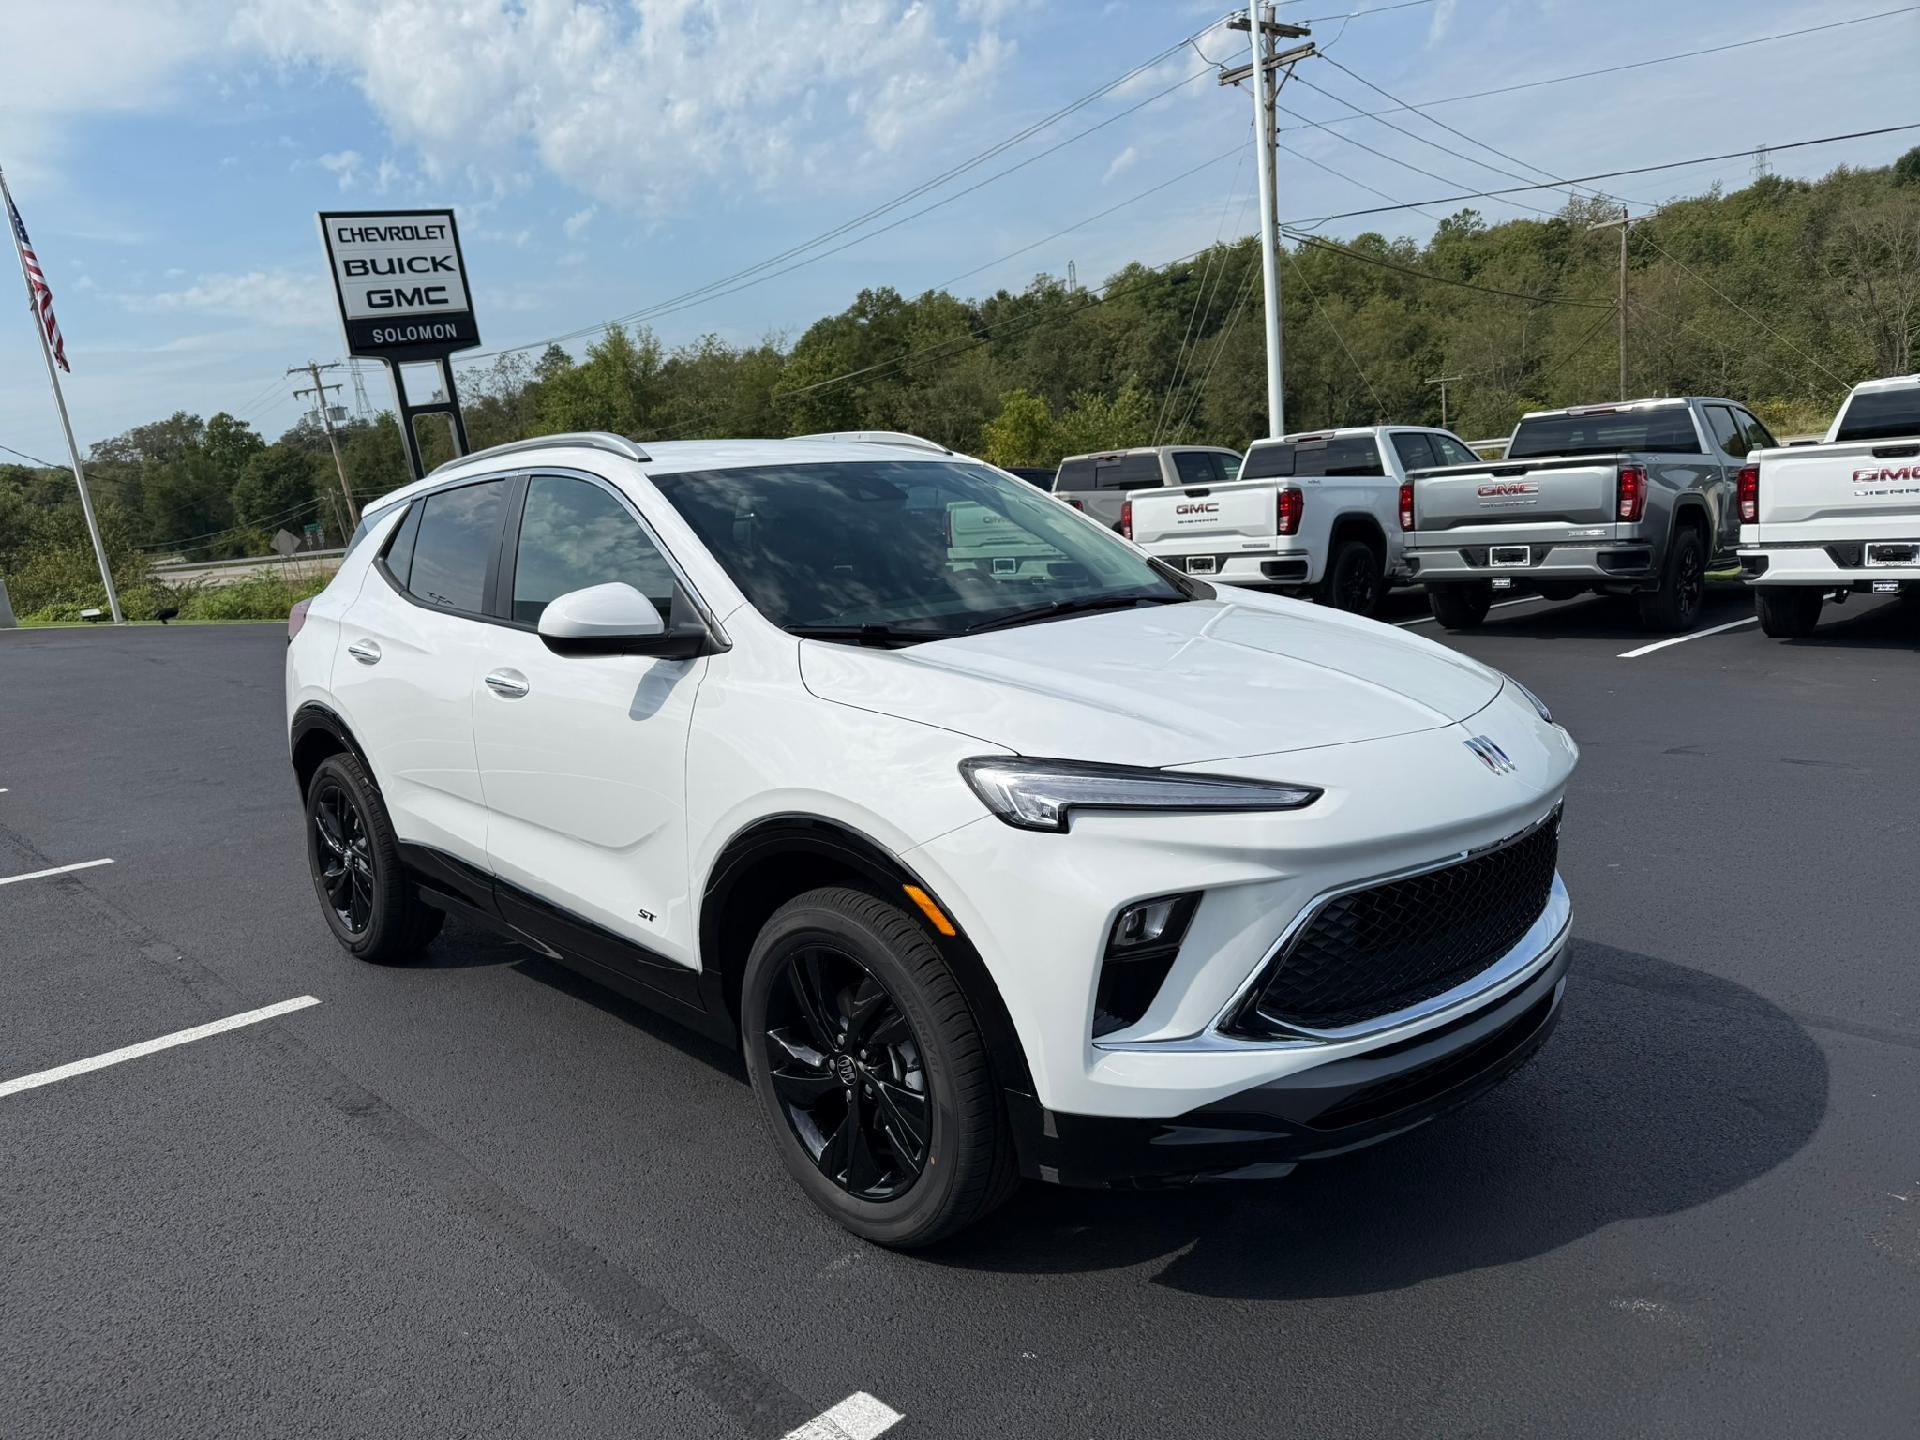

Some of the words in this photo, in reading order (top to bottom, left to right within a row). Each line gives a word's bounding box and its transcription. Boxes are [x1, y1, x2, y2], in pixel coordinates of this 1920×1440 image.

[337, 225, 446, 243] CHEVROLET
[343, 255, 456, 277] BUICK
[366, 286, 449, 309] GMC
[372, 323, 458, 343] SOLOMON
[1477, 482, 1539, 498] GMC
[1176, 502, 1220, 515] GMC
[637, 908, 657, 923] ST
